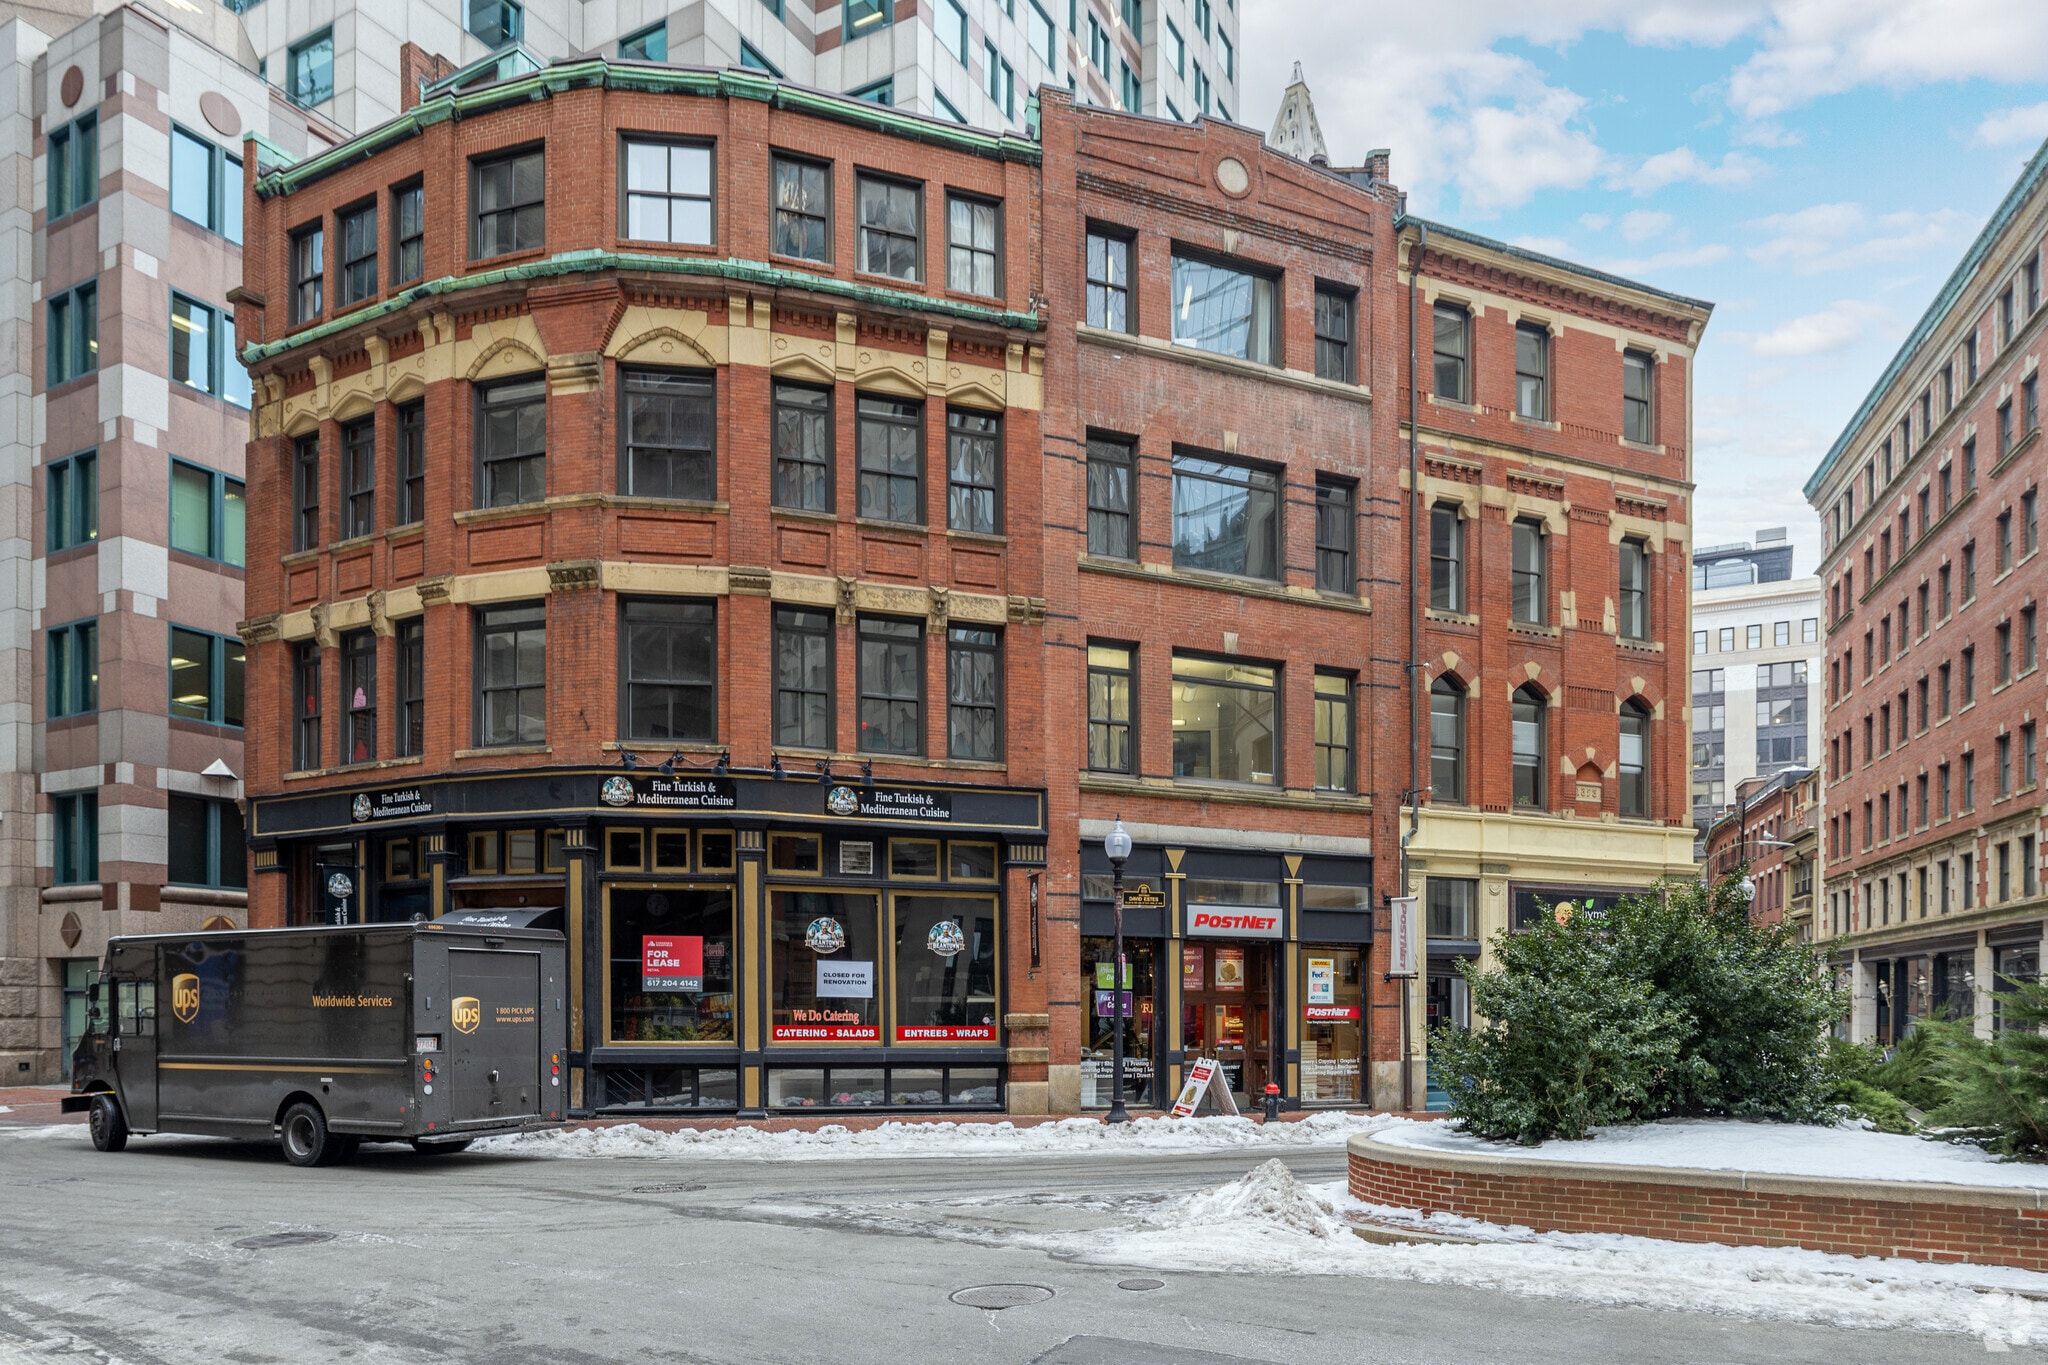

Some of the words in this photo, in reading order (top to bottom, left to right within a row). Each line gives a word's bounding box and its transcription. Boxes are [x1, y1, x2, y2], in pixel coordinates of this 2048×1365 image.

[652, 780, 671, 791] Fine
[673, 781, 706, 792] Turkish
[708, 782, 716, 792] &
[381, 794, 393, 804] Fine
[393, 790, 414, 802] Turkish
[414, 790, 420, 800] &
[637, 793, 699, 805] Mediterranean
[701, 795, 734, 806] Cuisine
[875, 792, 893, 802] Fine
[894, 793, 924, 804] Turkish
[926, 795, 933, 805] &
[373, 805, 410, 817] Mediterranean
[410, 802, 432, 813] Cuisine
[860, 803, 918, 816] Mediterranean
[920, 807, 950, 818] Cuisine
[647, 950, 668, 958] FOR
[647, 959, 680, 967] LEASE
[174, 988, 198, 1016] ups
[312, 995, 355, 1007] Worldwide
[358, 995, 392, 1007] Services
[454, 1008, 478, 1028] ups
[793, 1009, 806, 1021] We
[808, 1009, 822, 1021] Do
[823, 1009, 859, 1025] Catering
[776, 1029, 828, 1037] CATERING
[836, 1029, 875, 1037] SALADS
